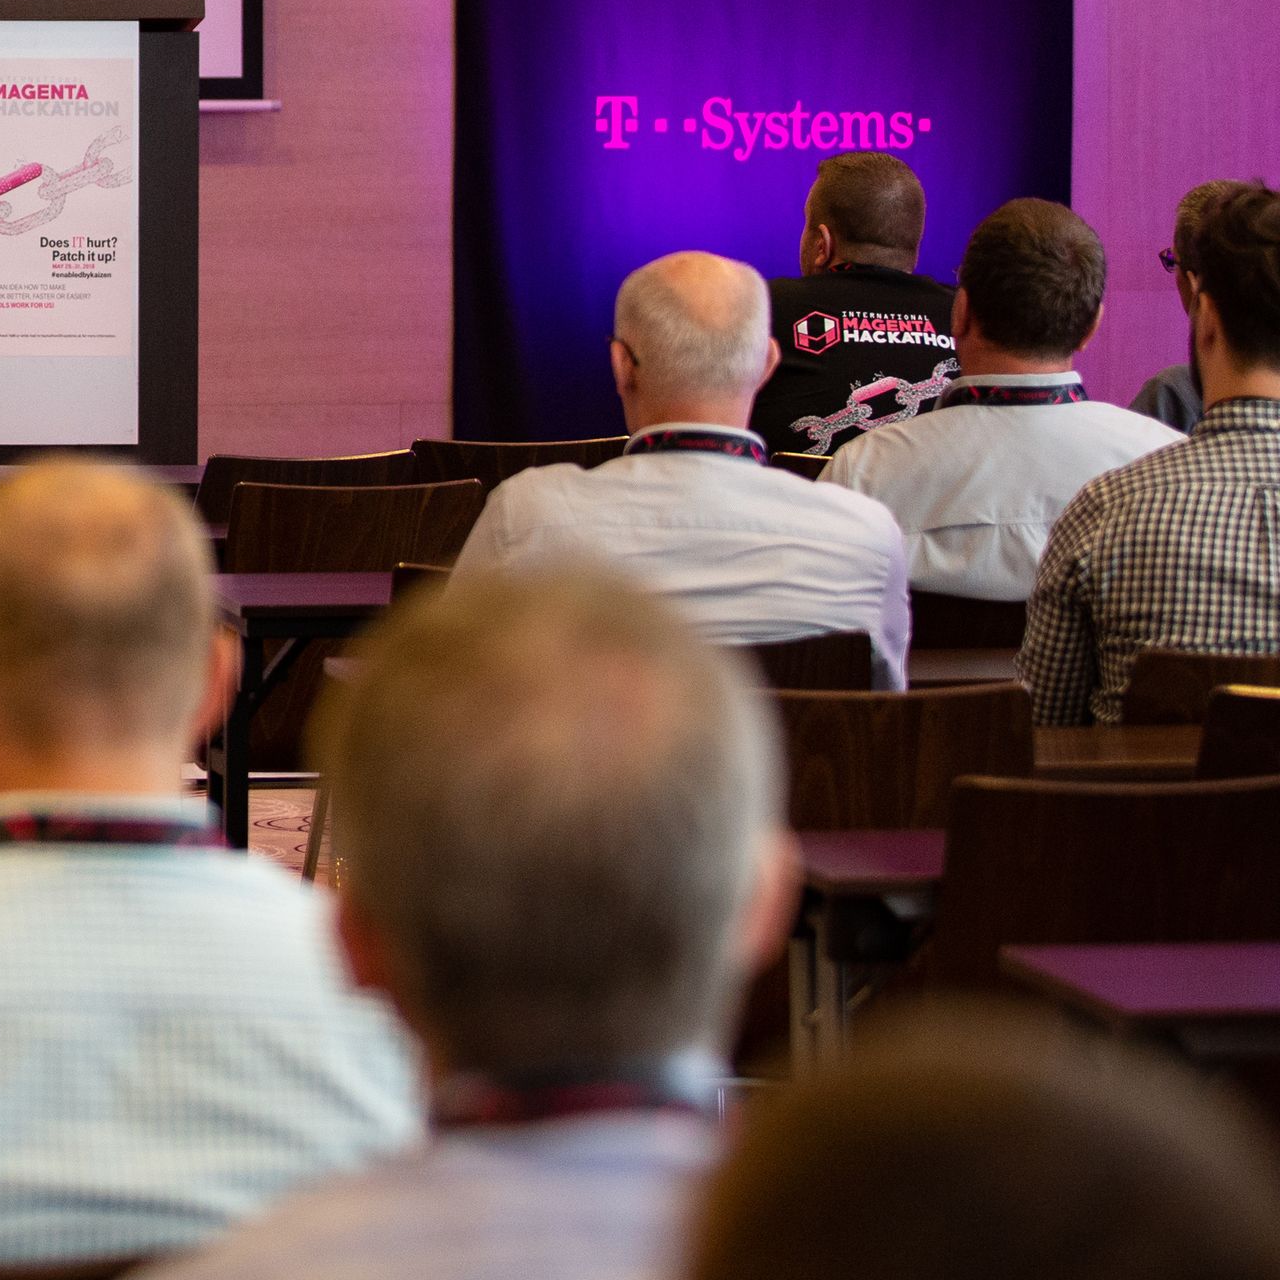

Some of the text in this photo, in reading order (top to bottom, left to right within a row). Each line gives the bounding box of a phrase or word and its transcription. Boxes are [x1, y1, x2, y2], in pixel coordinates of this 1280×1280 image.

[40, 236, 118, 248] Does IT hurt?
[52, 250, 116, 264] Patch it up!
[51, 271, 112, 279] #enabledbykaizen
[842, 311, 930, 321] INTERNATIONAL
[843, 317, 937, 334] MAGENTA
